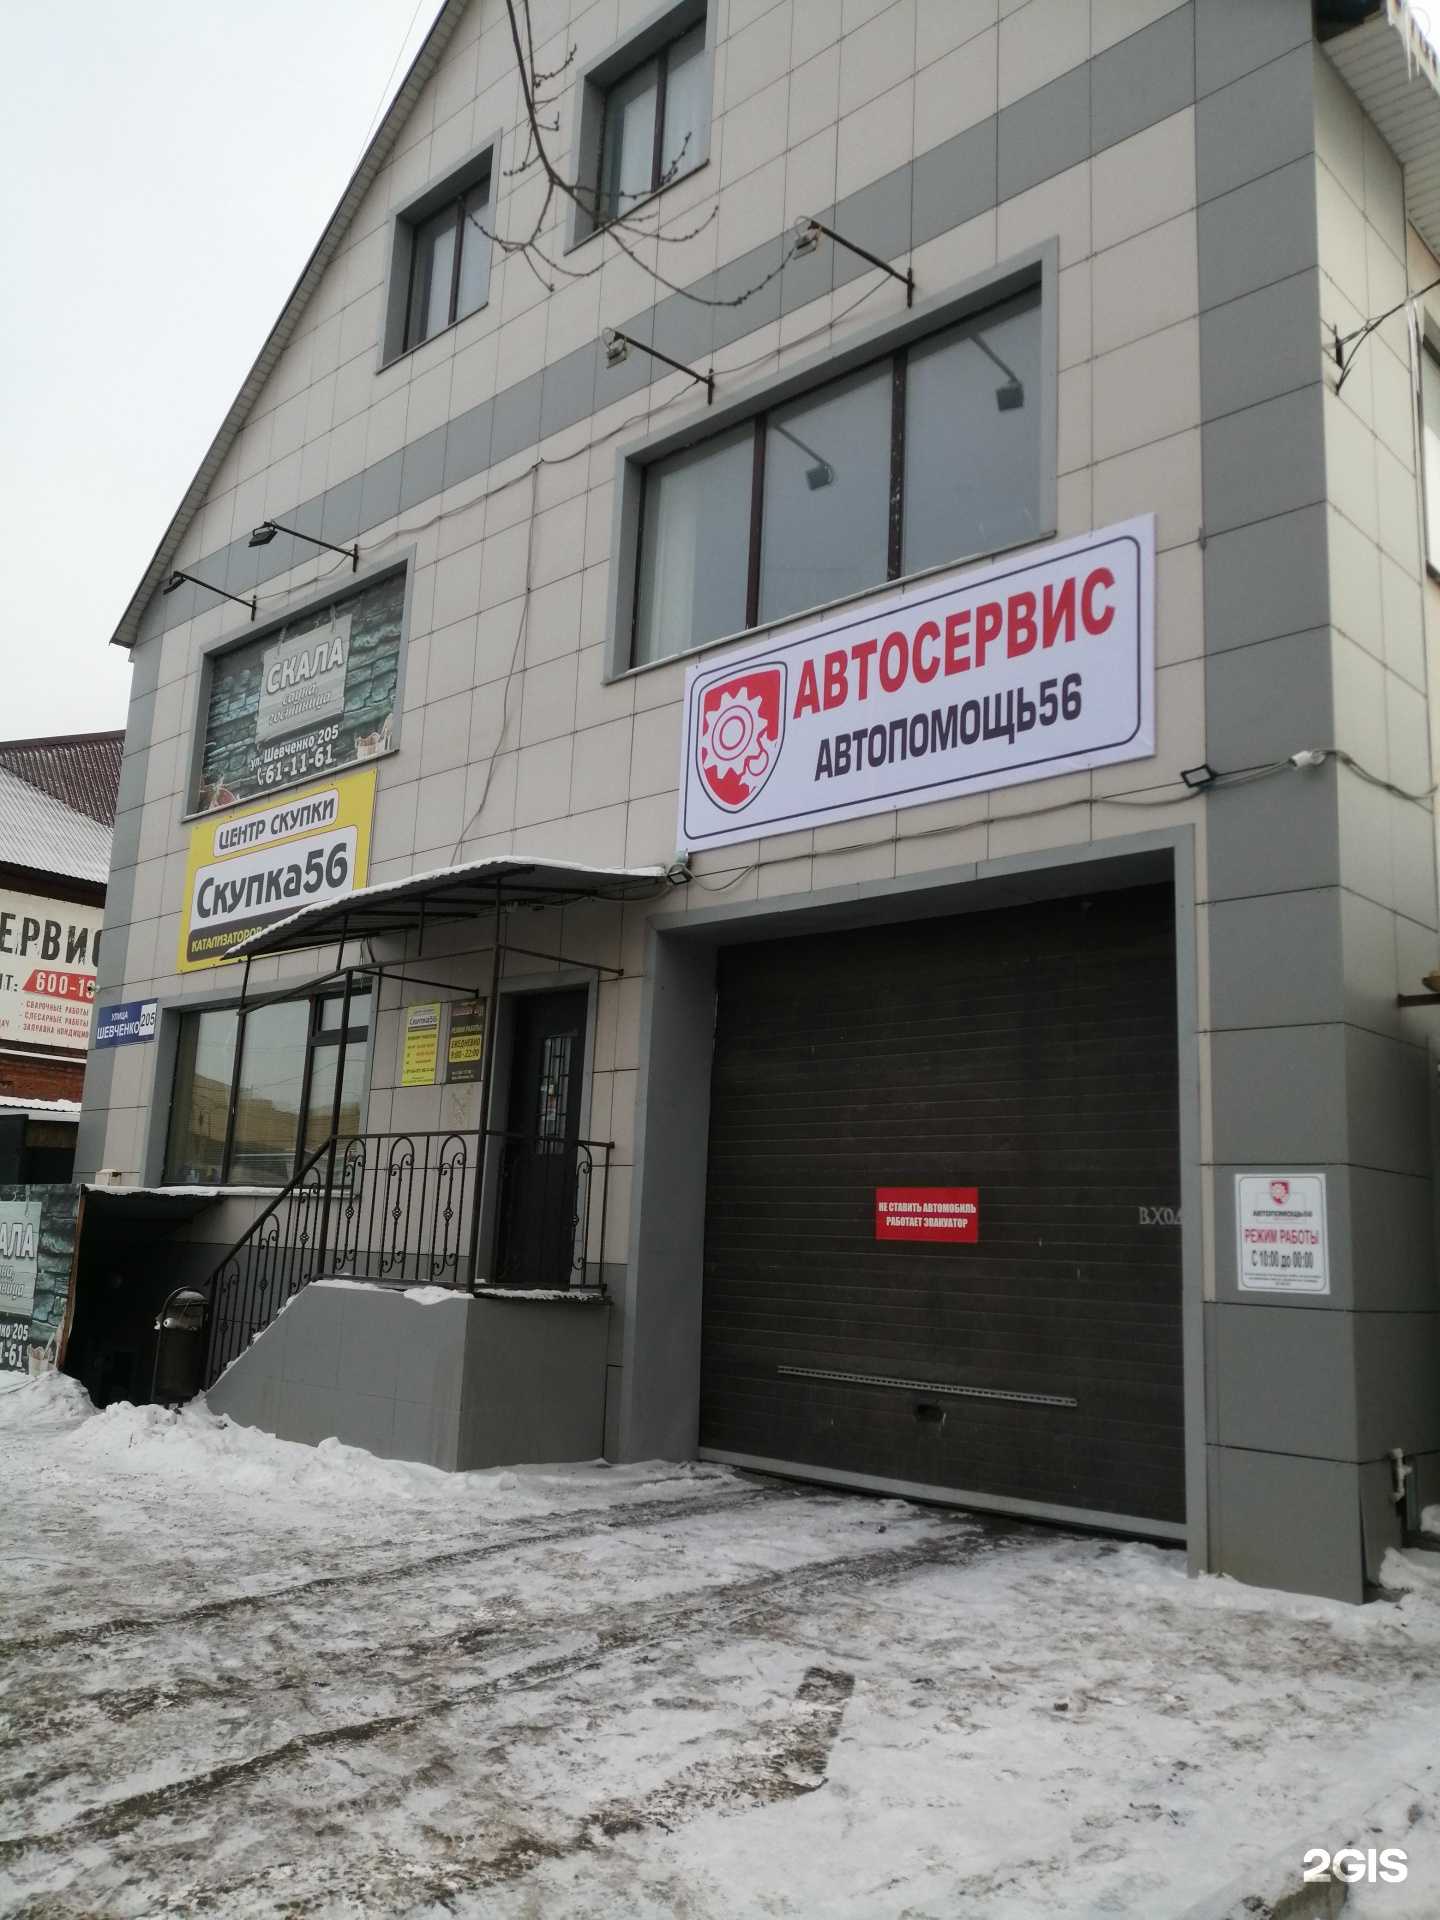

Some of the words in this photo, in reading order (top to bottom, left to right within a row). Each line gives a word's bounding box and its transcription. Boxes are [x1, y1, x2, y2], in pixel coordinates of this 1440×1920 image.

[793, 566, 1116, 720] АВТОСЕРВИС
[266, 637, 343, 694] СКАЛА
[317, 724, 338, 744] 205
[814, 672, 1083, 781] АВТОПОМОЩЬ56
[219, 819, 265, 850] ЦЕНТР
[270, 798, 335, 835] СКУПКИ
[197, 842, 348, 919] Скупка56
[65, 1005, 89, 1016] РАБОТЫ
[97, 1021, 140, 1039] ШЕВЧЕНКО
[141, 1012, 156, 1027] 205
[879, 1202, 888, 1212] НЕ
[889, 1202, 922, 1212] СТАВИТЬ
[923, 1203, 976, 1213] АВТОМОБИЛЬ
[886, 1216, 922, 1227] РАБОТАЕТ
[923, 1217, 968, 1228] ЭВАКУАТОР
[1244, 1229, 1277, 1244] РЕЖИМ
[1280, 1229, 1319, 1245] РАБОТЫ
[12, 1322, 28, 1341] 205
